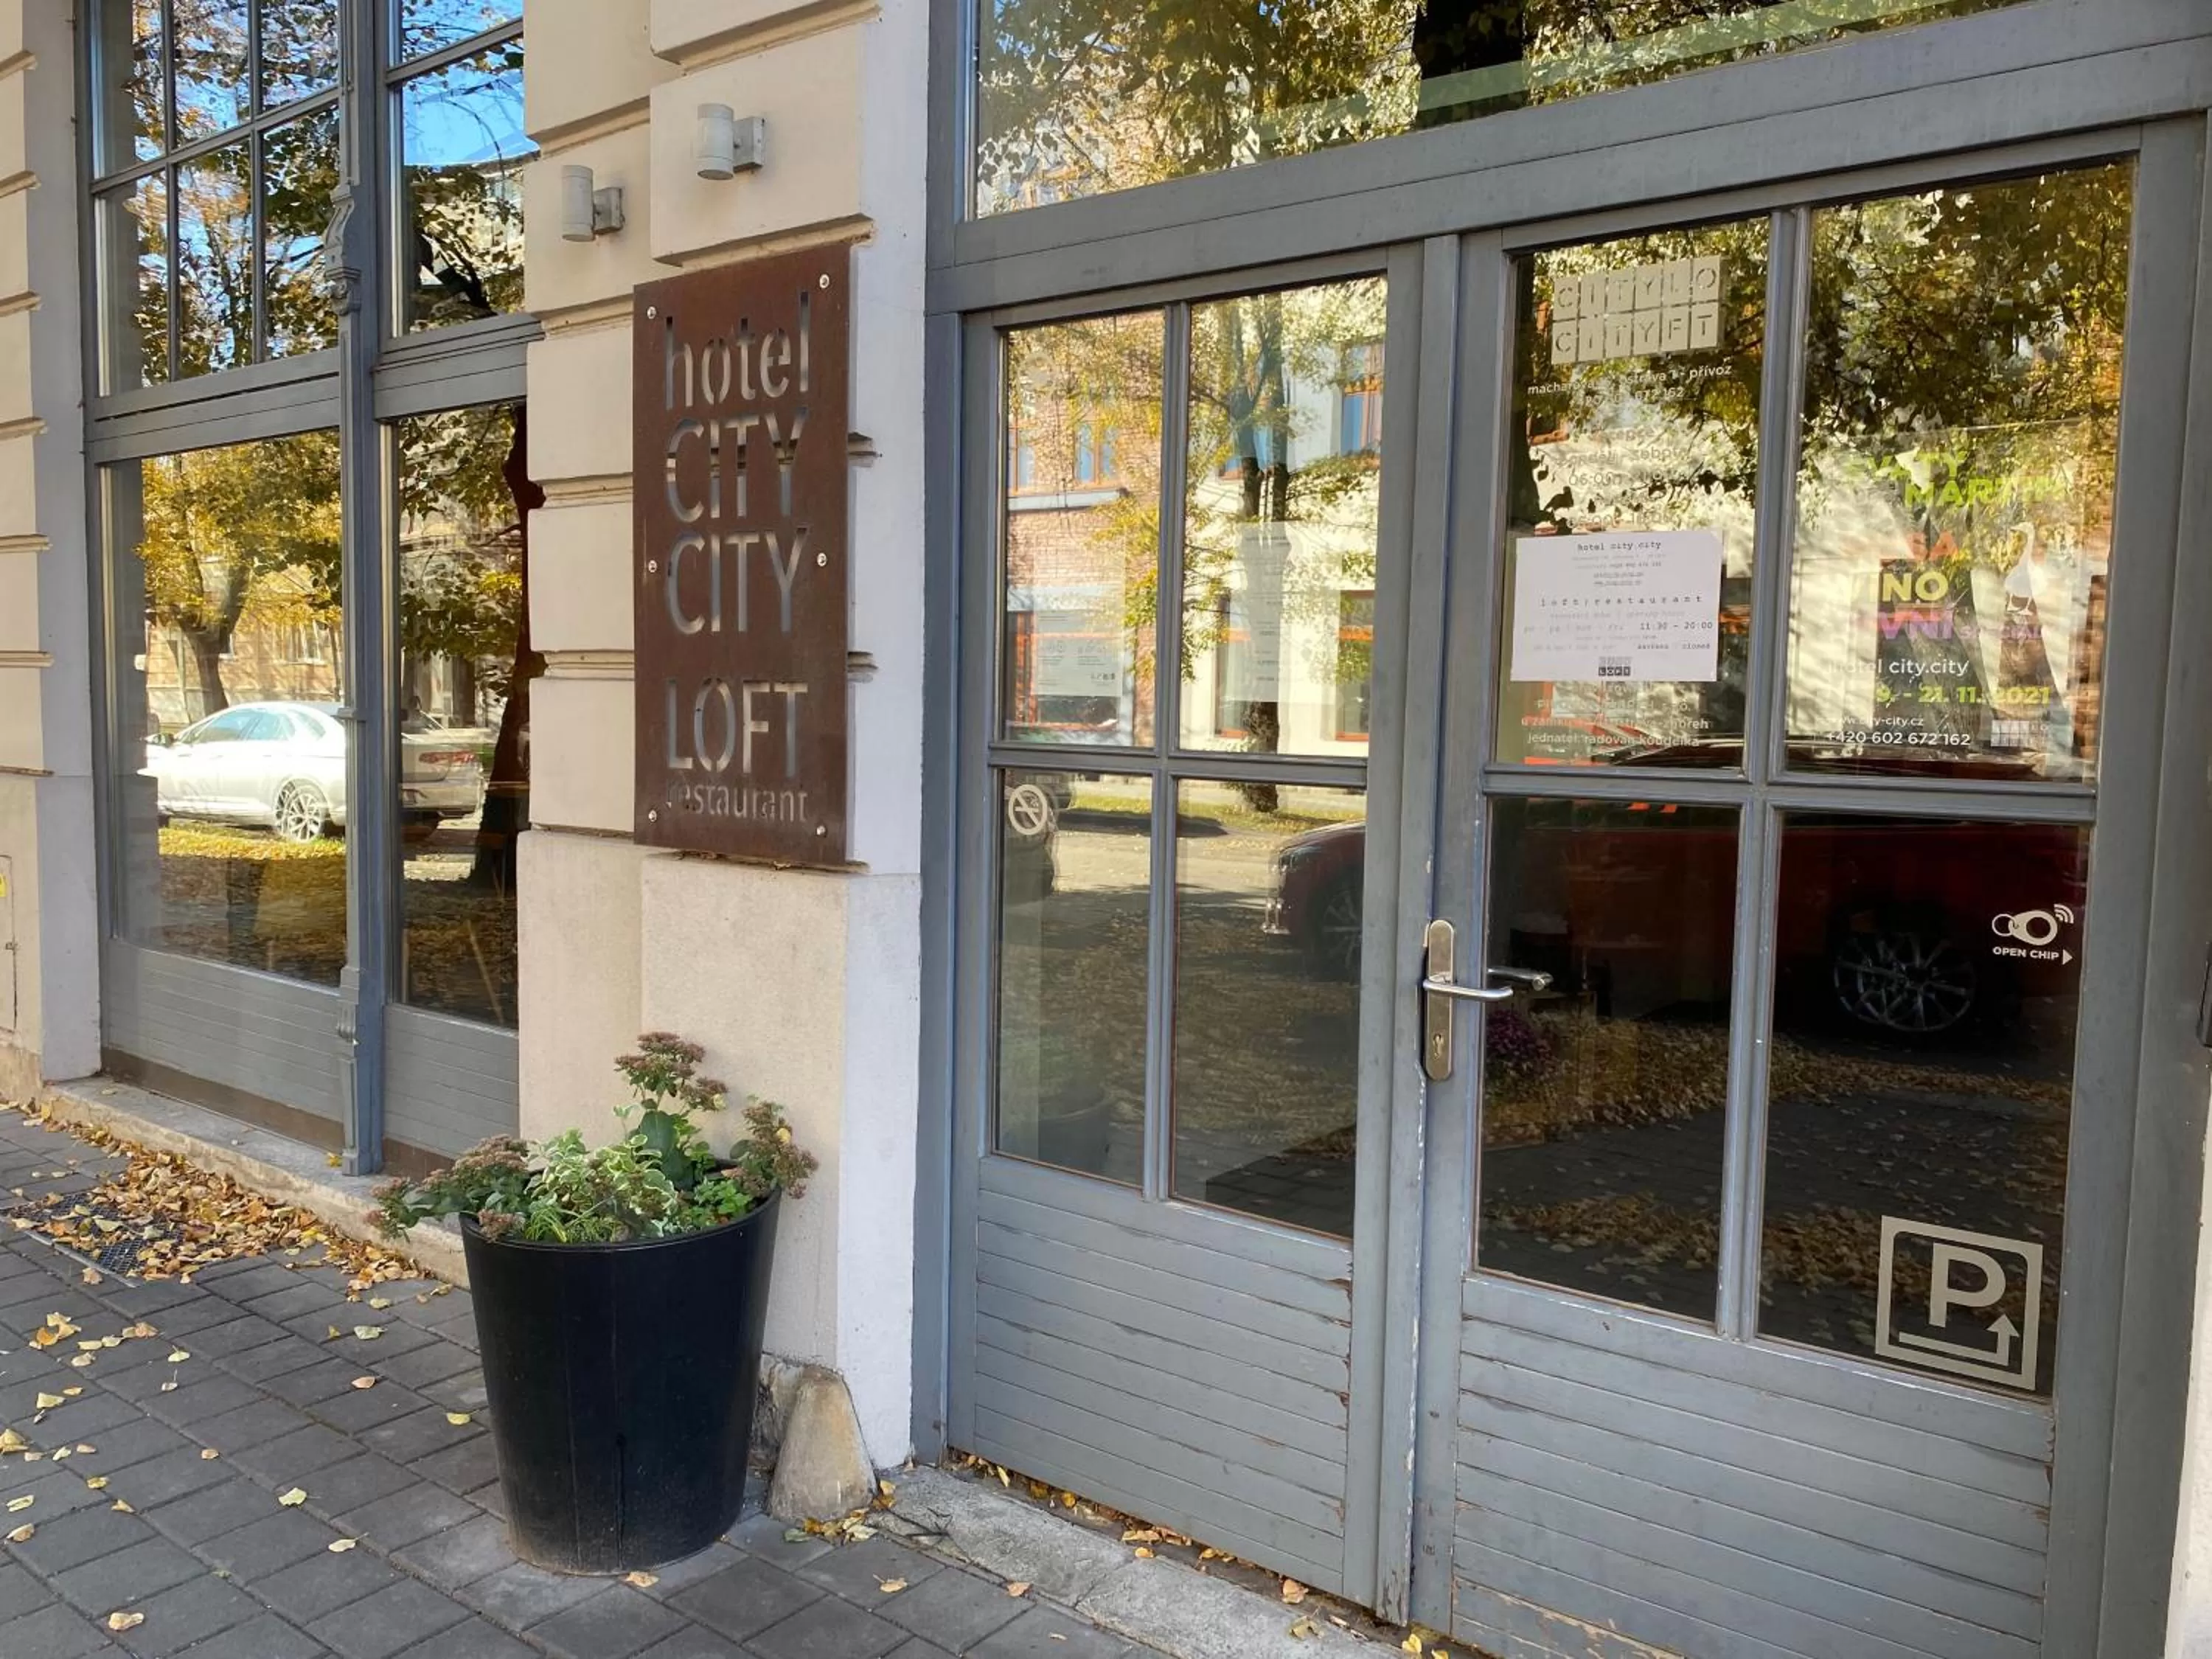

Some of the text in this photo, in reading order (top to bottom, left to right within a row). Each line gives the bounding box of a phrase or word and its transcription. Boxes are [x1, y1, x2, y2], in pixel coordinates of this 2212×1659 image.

[665, 291, 810, 410] hotel
[1689, 364, 1732, 381] přívoz
[667, 406, 810, 524] CITY
[1577, 541, 1661, 551] hotel city city
[667, 526, 810, 636] CITY
[1888, 658, 1969, 676] city.city
[666, 675, 809, 779] LOFT
[1828, 730, 1971, 746] +420 602 672 162
[667, 779, 809, 823] restaurant
[1992, 946, 2059, 960] OPEN CHIP
[1929, 1242, 2006, 1328] P
